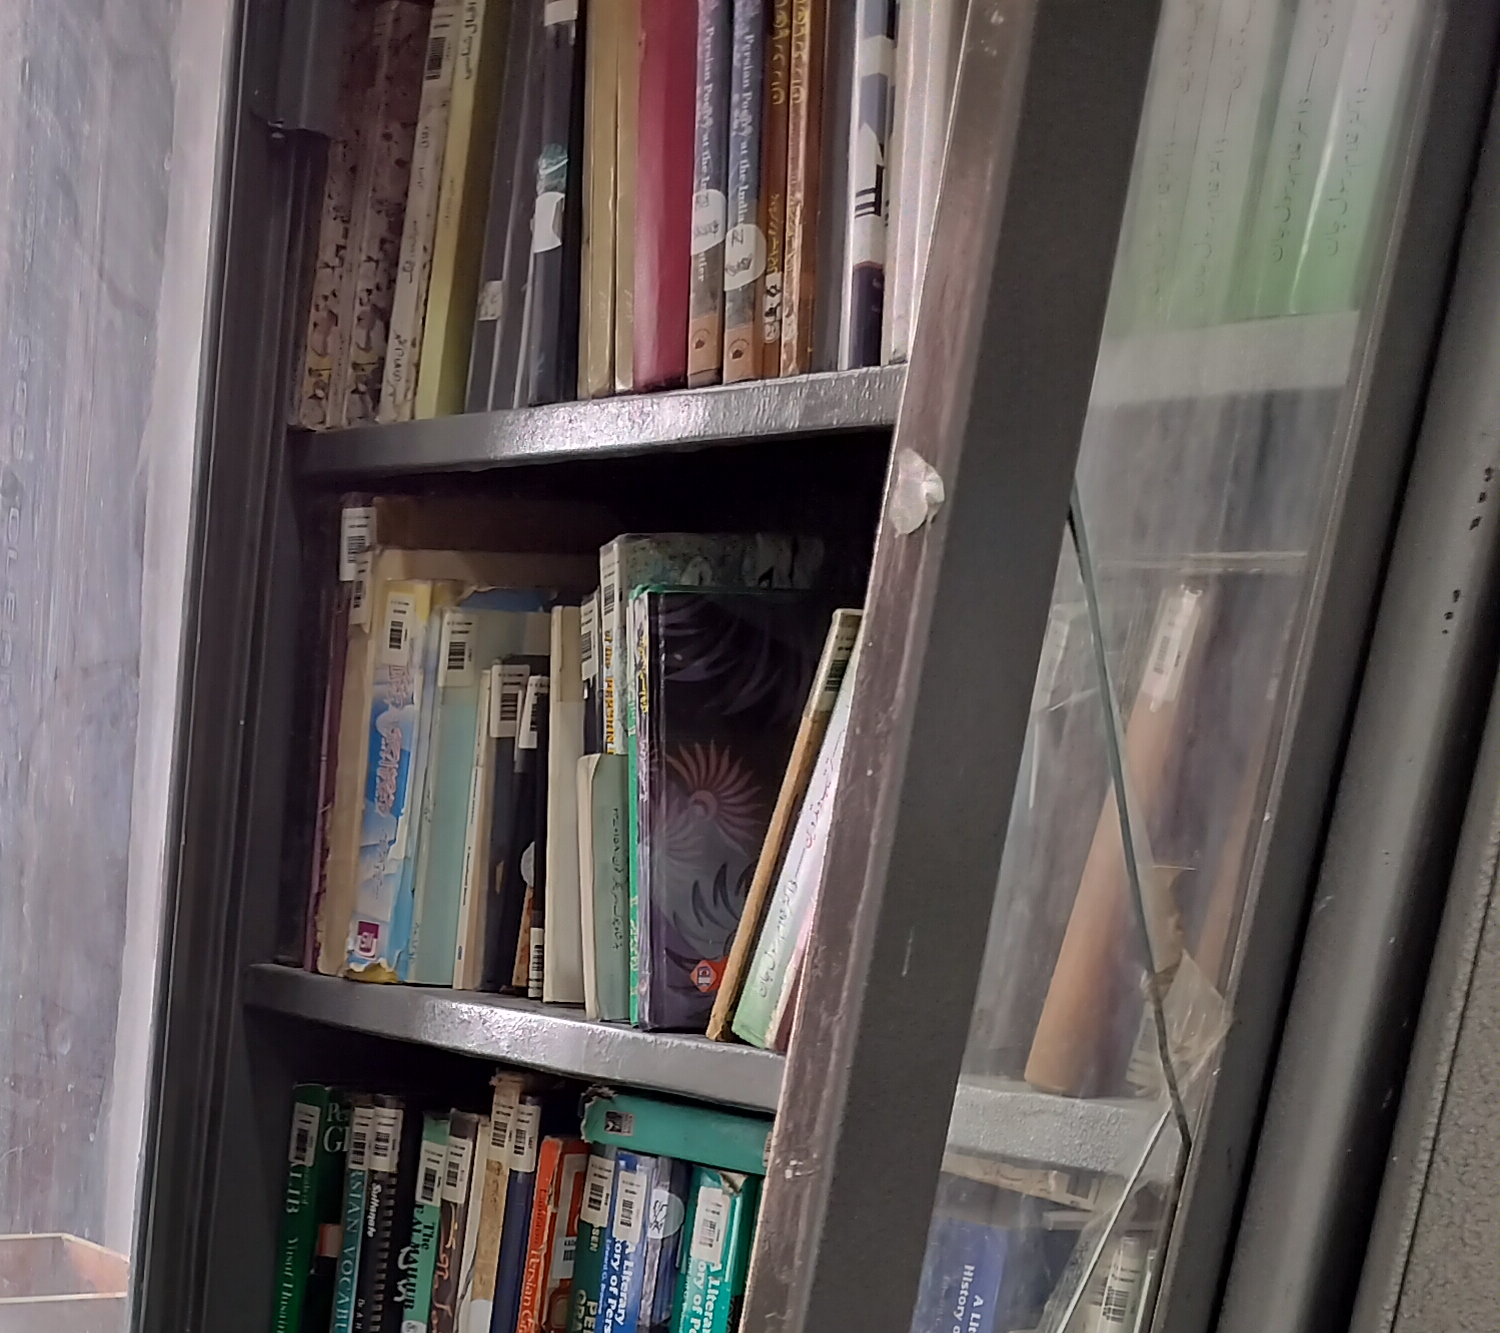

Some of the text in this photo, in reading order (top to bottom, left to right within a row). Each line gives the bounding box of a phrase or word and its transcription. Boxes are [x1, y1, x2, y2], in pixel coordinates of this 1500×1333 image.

[704, 26, 715, 80] Persian
[742, 34, 754, 88] Persian
[286, 1161, 302, 1214] LIB
[346, 1170, 365, 1216] SIAN
[366, 1182, 383, 1239] Sultanate
[422, 1222, 435, 1251] The
[521, 1249, 540, 1308] Persian
[615, 1258, 635, 1326] Literary
[953, 1263, 976, 1322] History
[973, 1294, 985, 1308] A
